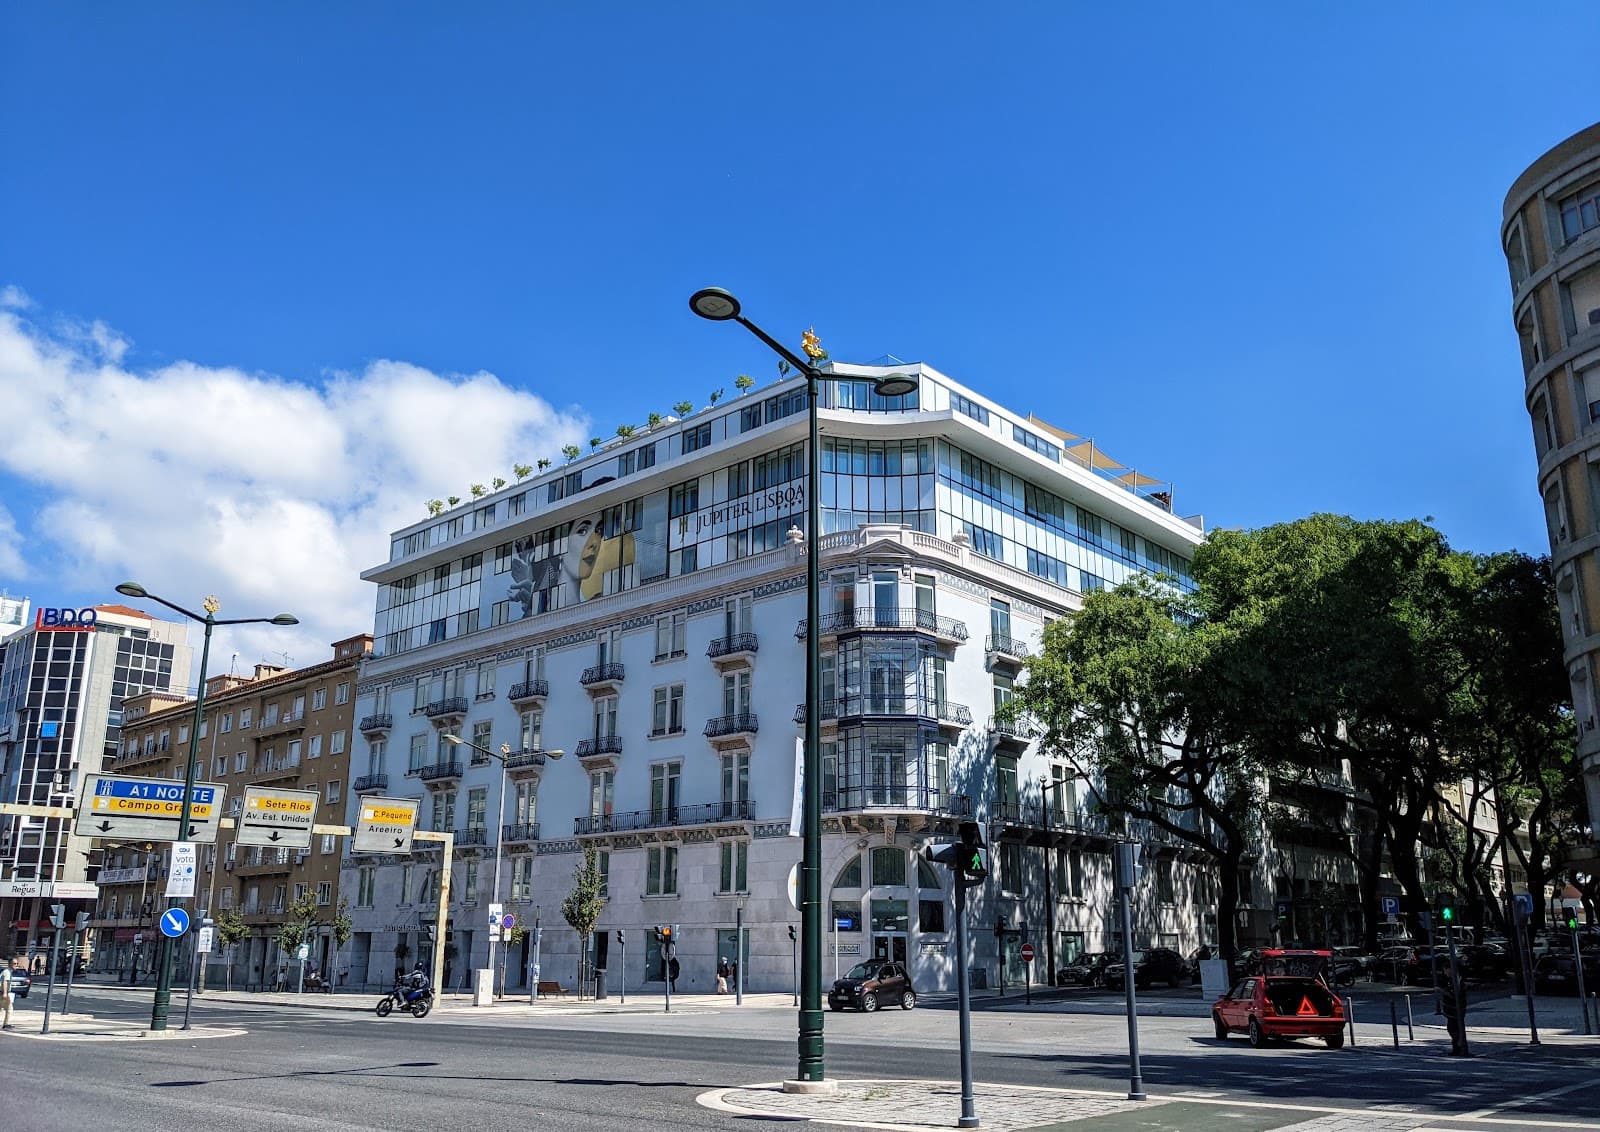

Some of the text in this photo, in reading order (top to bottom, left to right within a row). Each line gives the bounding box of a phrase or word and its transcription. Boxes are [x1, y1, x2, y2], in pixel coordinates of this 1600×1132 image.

[696, 501, 752, 533] JUPITER
[756, 484, 804, 512] LISBOA
[44, 607, 97, 626] BDO
[130, 785, 148, 797] A1
[118, 799, 207, 814] Campo Grade
[265, 800, 311, 811] Sete Rios
[245, 812, 310, 823] Av. Est. Unidos
[368, 825, 403, 834] Areeiro
[11, 885, 36, 895] Regus
